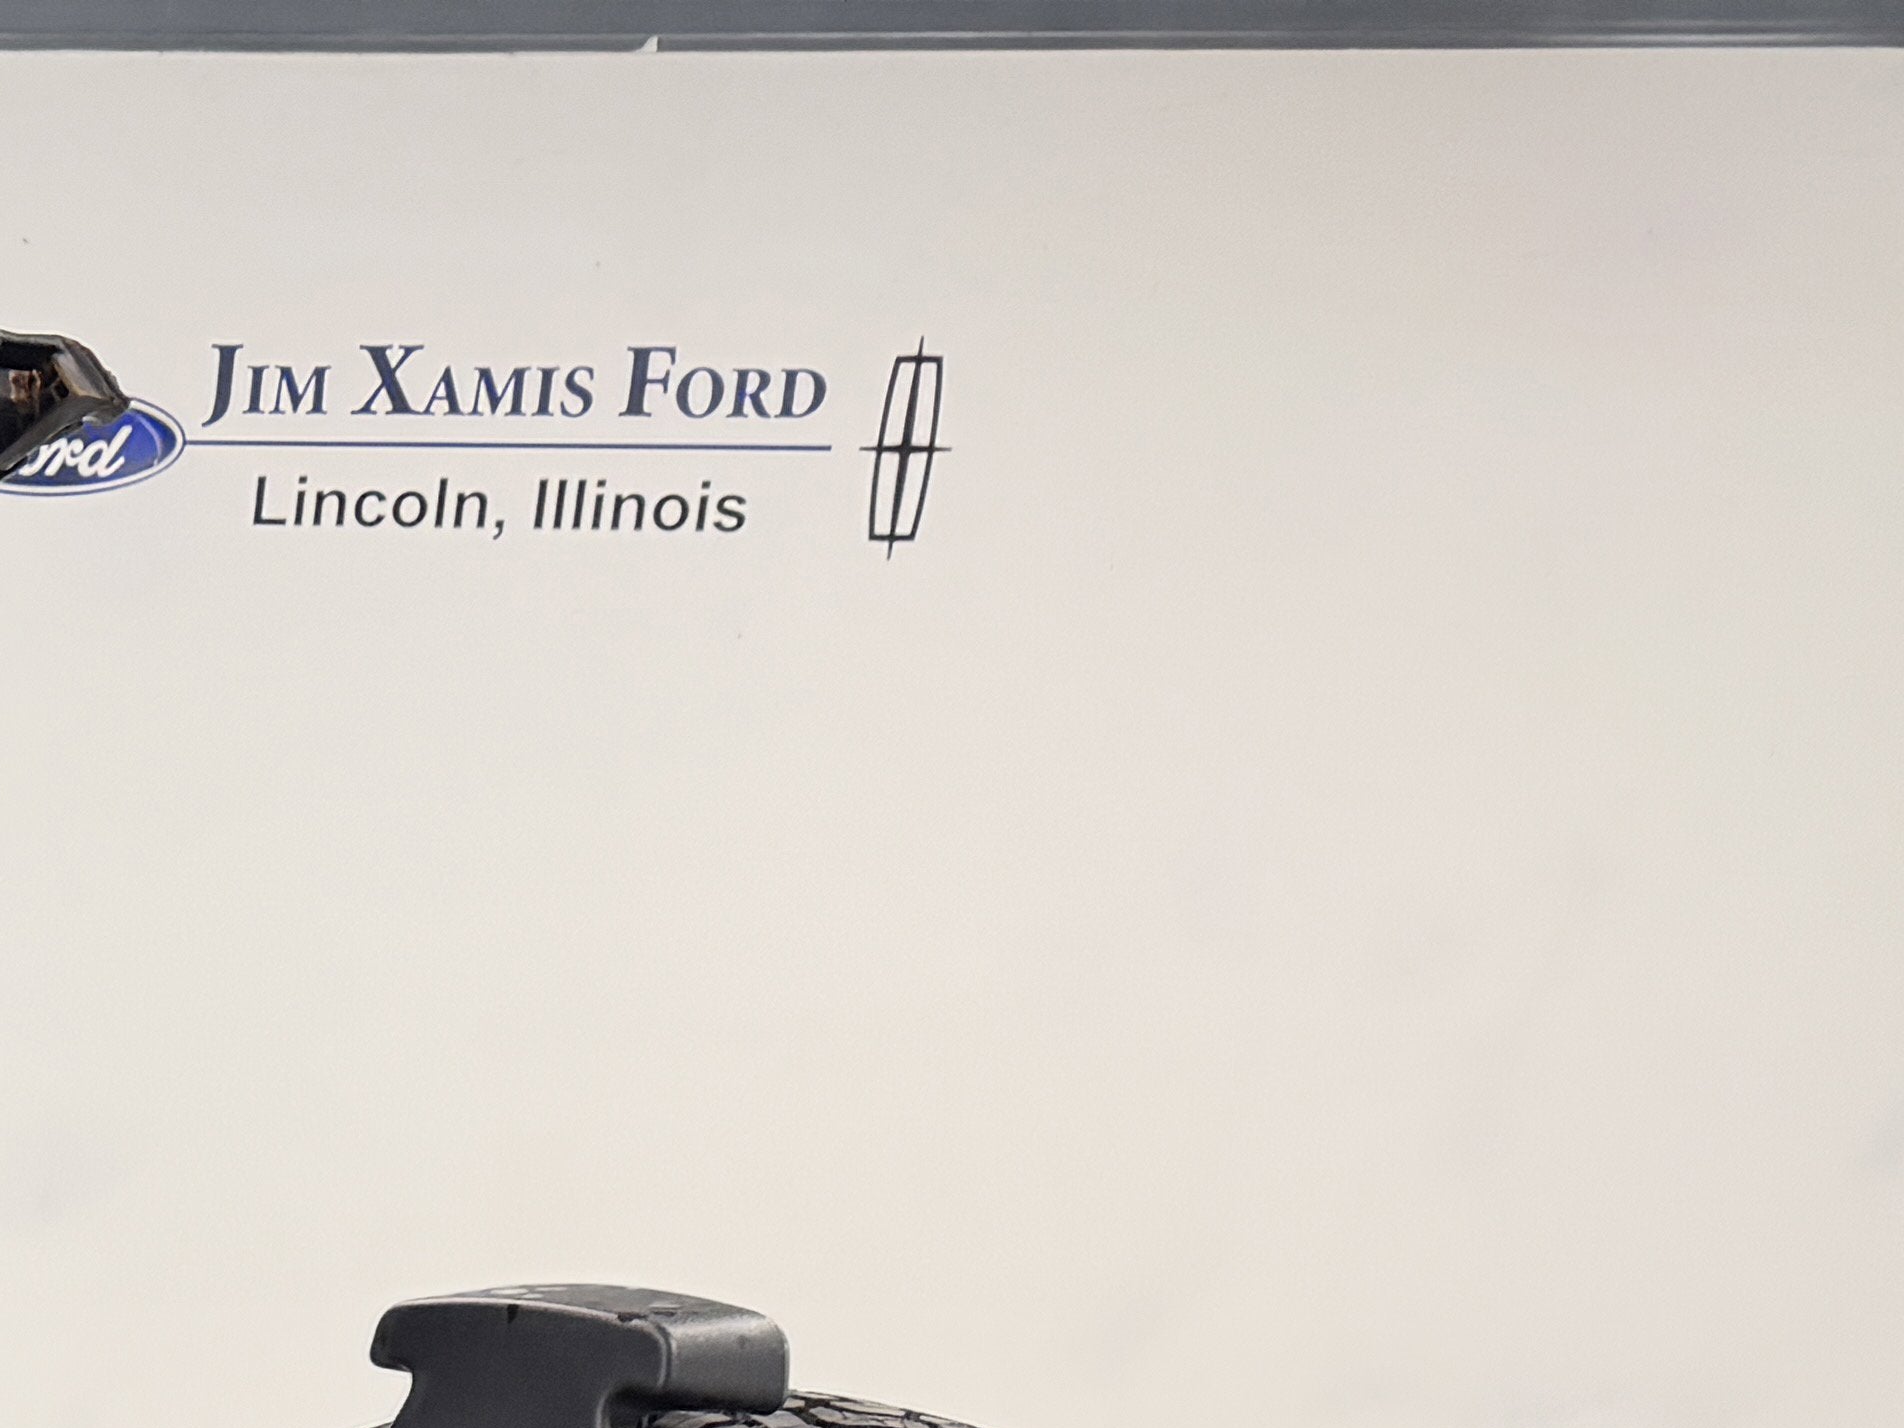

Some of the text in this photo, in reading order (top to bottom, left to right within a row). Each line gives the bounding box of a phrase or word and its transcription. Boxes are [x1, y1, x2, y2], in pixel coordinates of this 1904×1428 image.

[202, 343, 828, 427] JIM XAMIS FORD
[252, 475, 748, 540] Lincoln, Illinois
